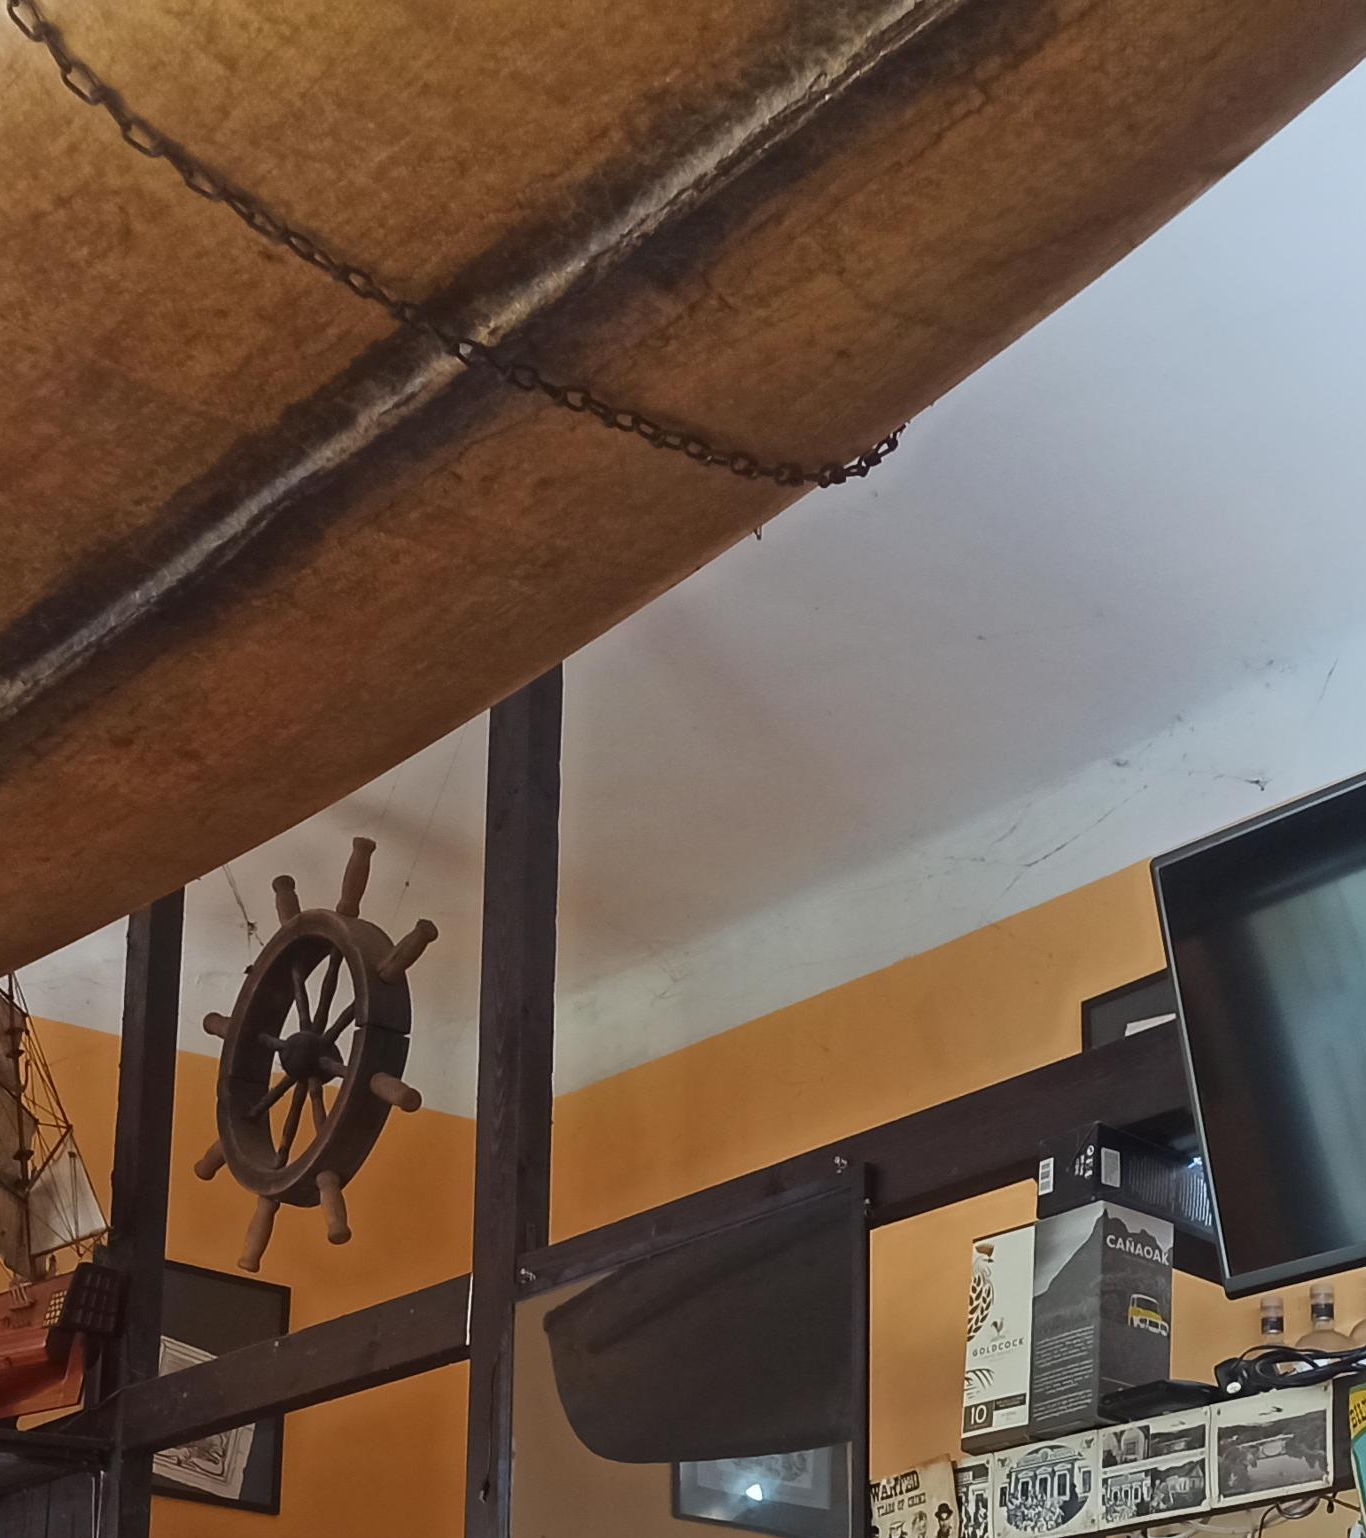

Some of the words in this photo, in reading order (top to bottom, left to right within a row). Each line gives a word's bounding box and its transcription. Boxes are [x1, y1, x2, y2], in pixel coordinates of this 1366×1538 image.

[1106, 1234, 1170, 1266] CAÑAOAK
[972, 1337, 1025, 1358] GOLDCOCK
[969, 1404, 987, 1425] 10
